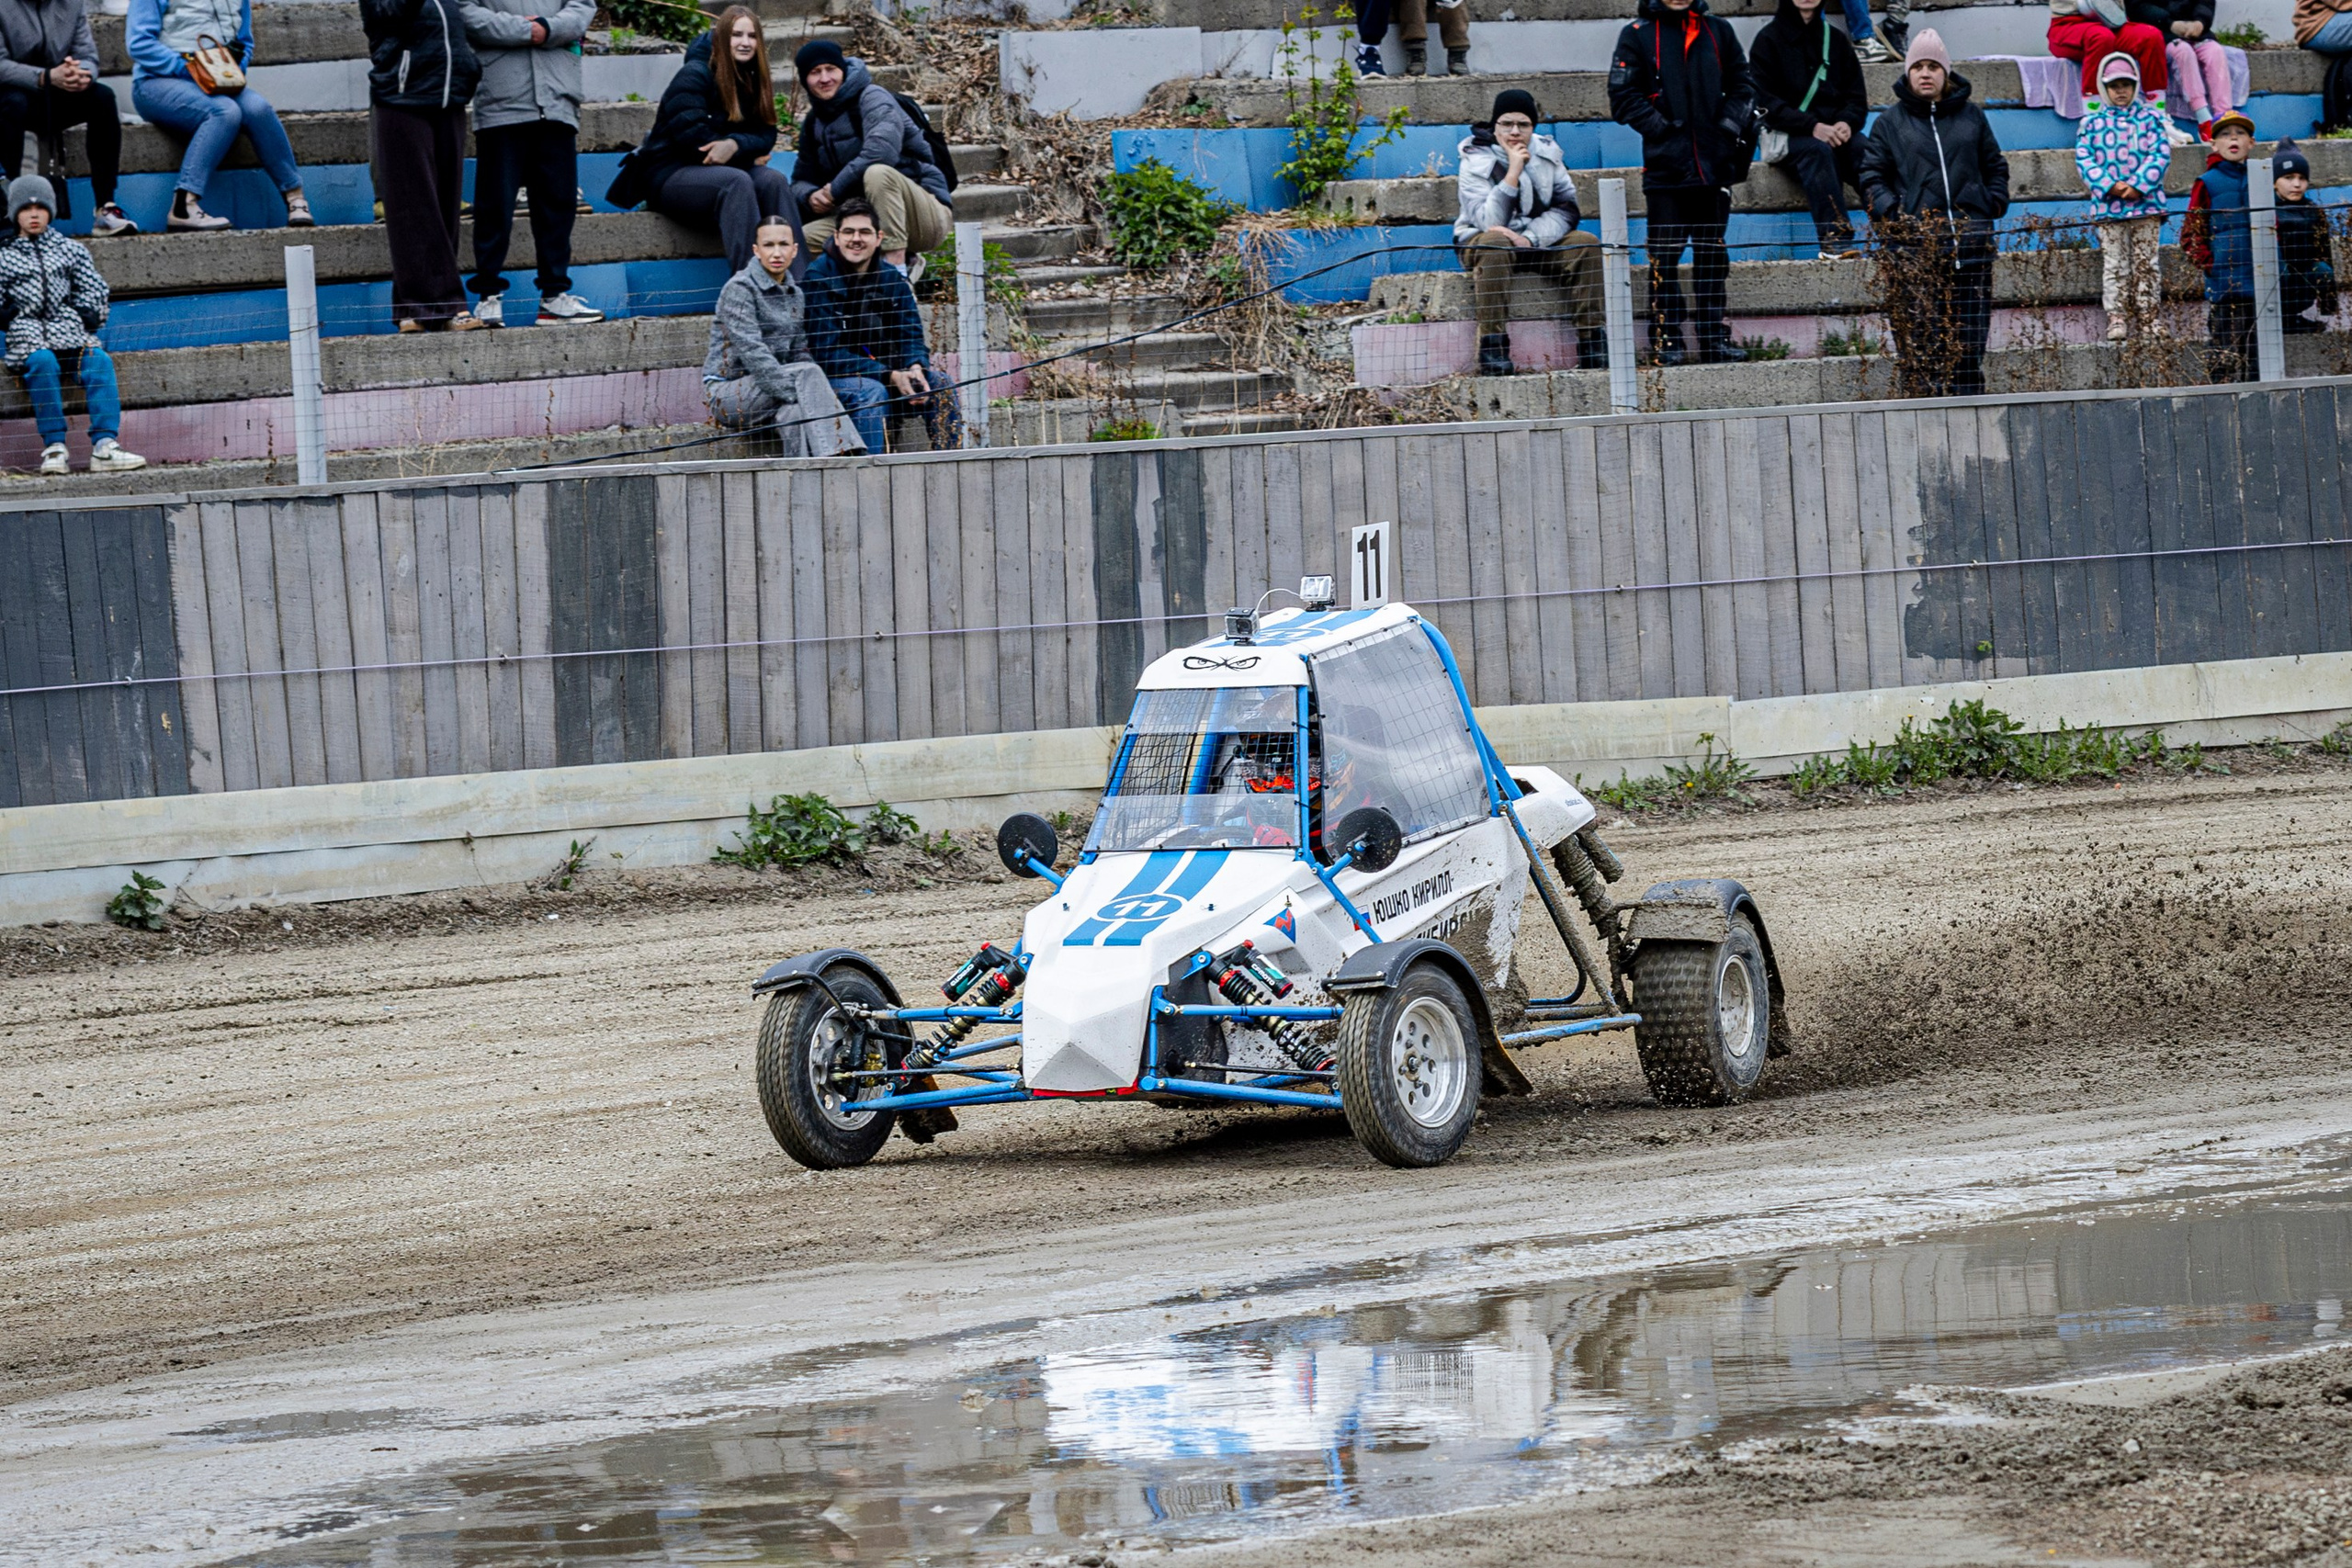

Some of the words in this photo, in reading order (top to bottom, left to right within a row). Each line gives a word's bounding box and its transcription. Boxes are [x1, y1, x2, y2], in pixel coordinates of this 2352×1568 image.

[1357, 529, 1382, 602] 11
[1113, 899, 1169, 917] 11
[1373, 888, 1410, 925] ЮШКО
[1411, 870, 1453, 909] КИРИЛЛ
[1250, 963, 1275, 987] CFMOTO
